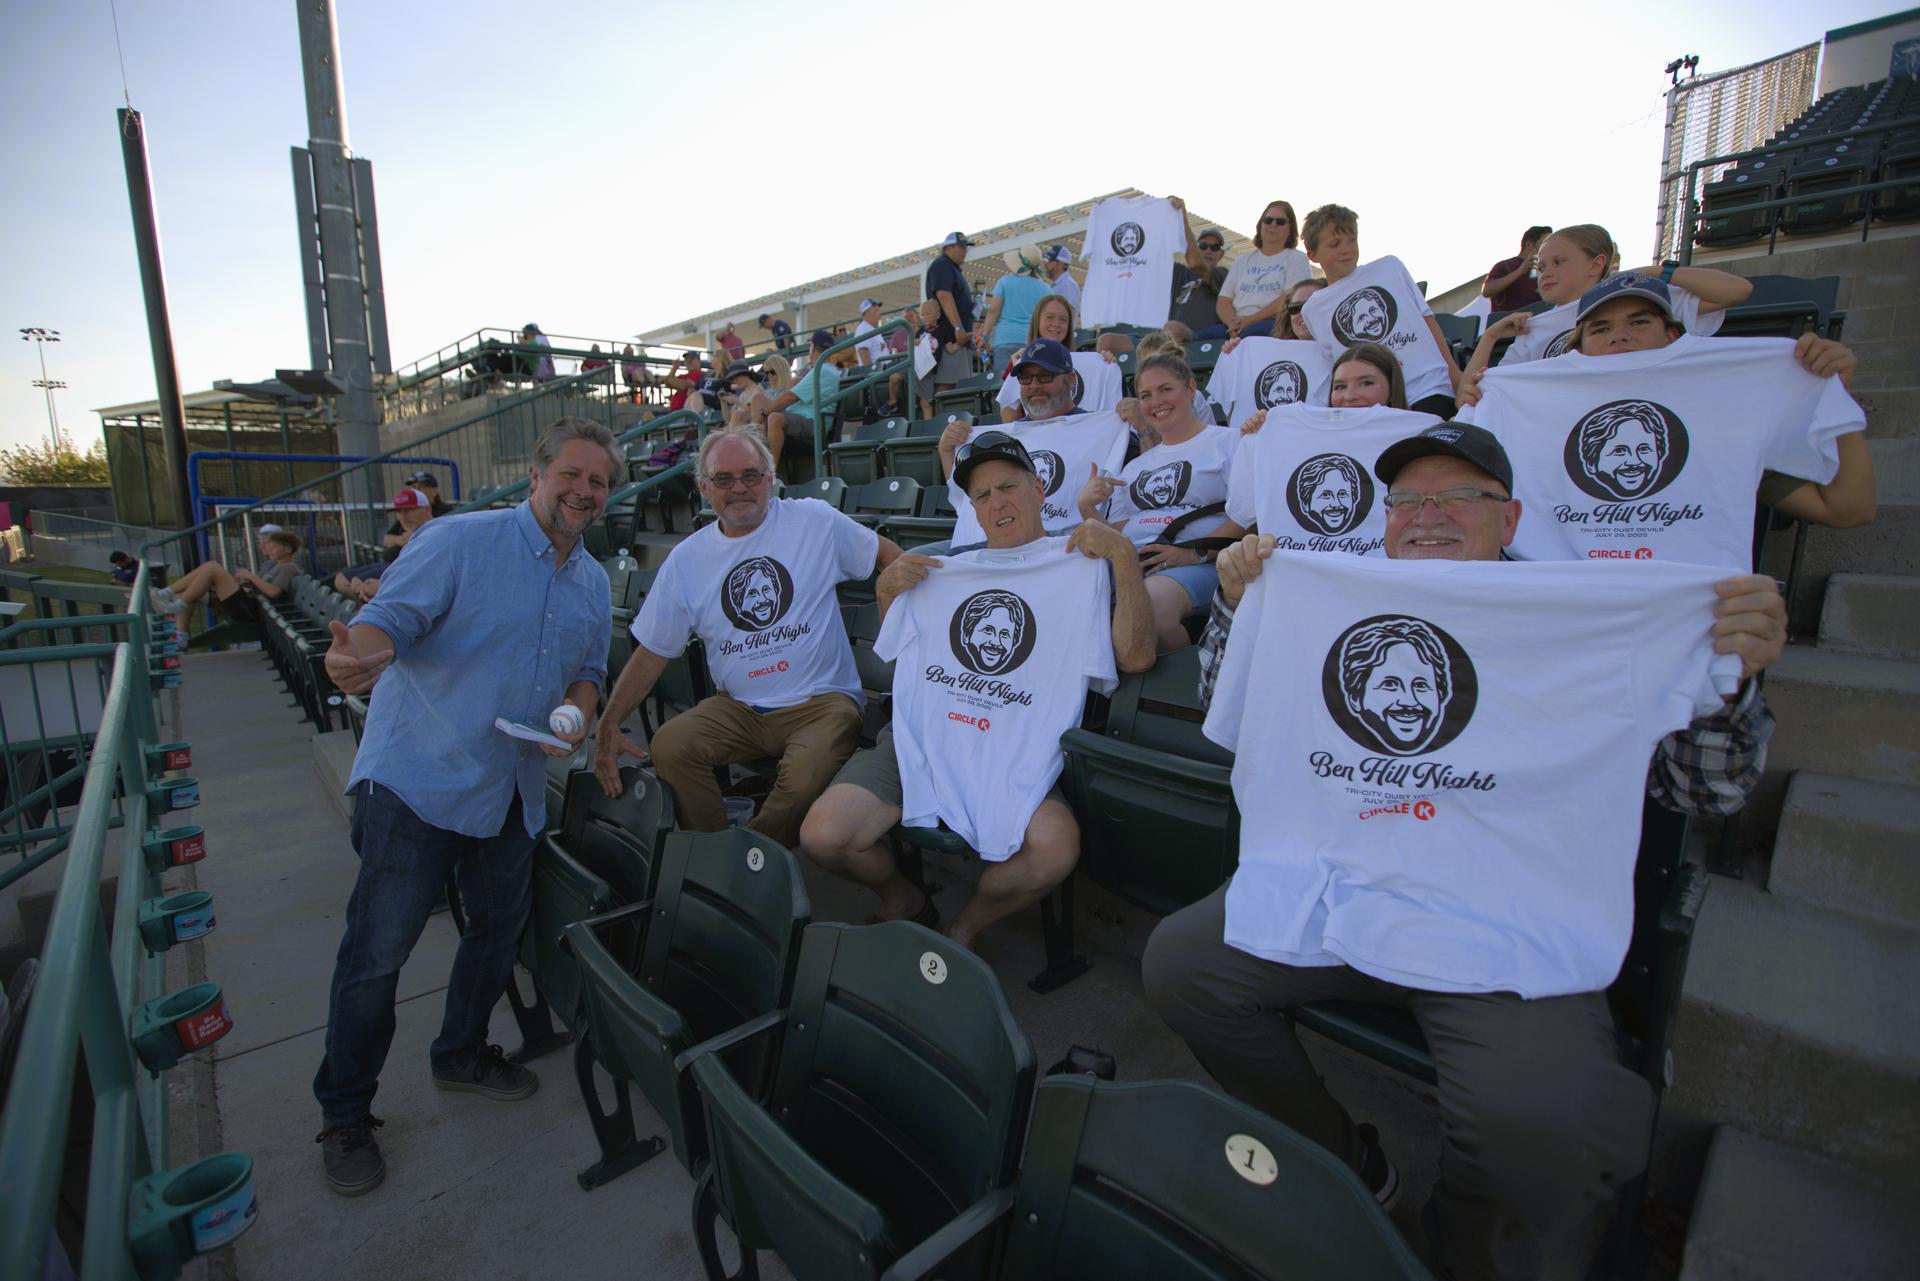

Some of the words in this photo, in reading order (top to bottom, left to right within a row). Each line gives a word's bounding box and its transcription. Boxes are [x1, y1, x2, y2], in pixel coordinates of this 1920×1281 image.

[1388, 332, 1418, 349] Night
[1553, 504, 1589, 524] Ben
[1593, 503, 1637, 524] Hill
[1636, 502, 1704, 527] Night
[1308, 536, 1337, 552] Hill
[1588, 549, 1631, 559] CIRCLE
[1635, 548, 1652, 560] K
[720, 640, 743, 656] Ben
[745, 631, 771, 649] Hill
[772, 622, 811, 642] Night
[748, 665, 776, 679] CIRCLE
[777, 660, 789, 672] K
[925, 665, 956, 688] Ben
[958, 672, 987, 694] Hill
[988, 680, 1033, 706] Night
[947, 711, 977, 725] CIRCLE
[977, 718, 991, 731] K
[1309, 751, 1355, 781] Ben
[1359, 757, 1413, 788] Hill
[1412, 762, 1497, 791] Night
[1345, 787, 1382, 797] TRI-CITY
[1384, 792, 1411, 800] DUST
[1362, 797, 1384, 805] JULY
[1359, 802, 1410, 820] CIRCLE
[1414, 800, 1435, 821] K
[752, 852, 759, 865] 3
[927, 959, 938, 976] 2
[199, 1016, 222, 1031] Game
[199, 1020, 224, 1038] Ready
[1243, 1148, 1255, 1171] 1
